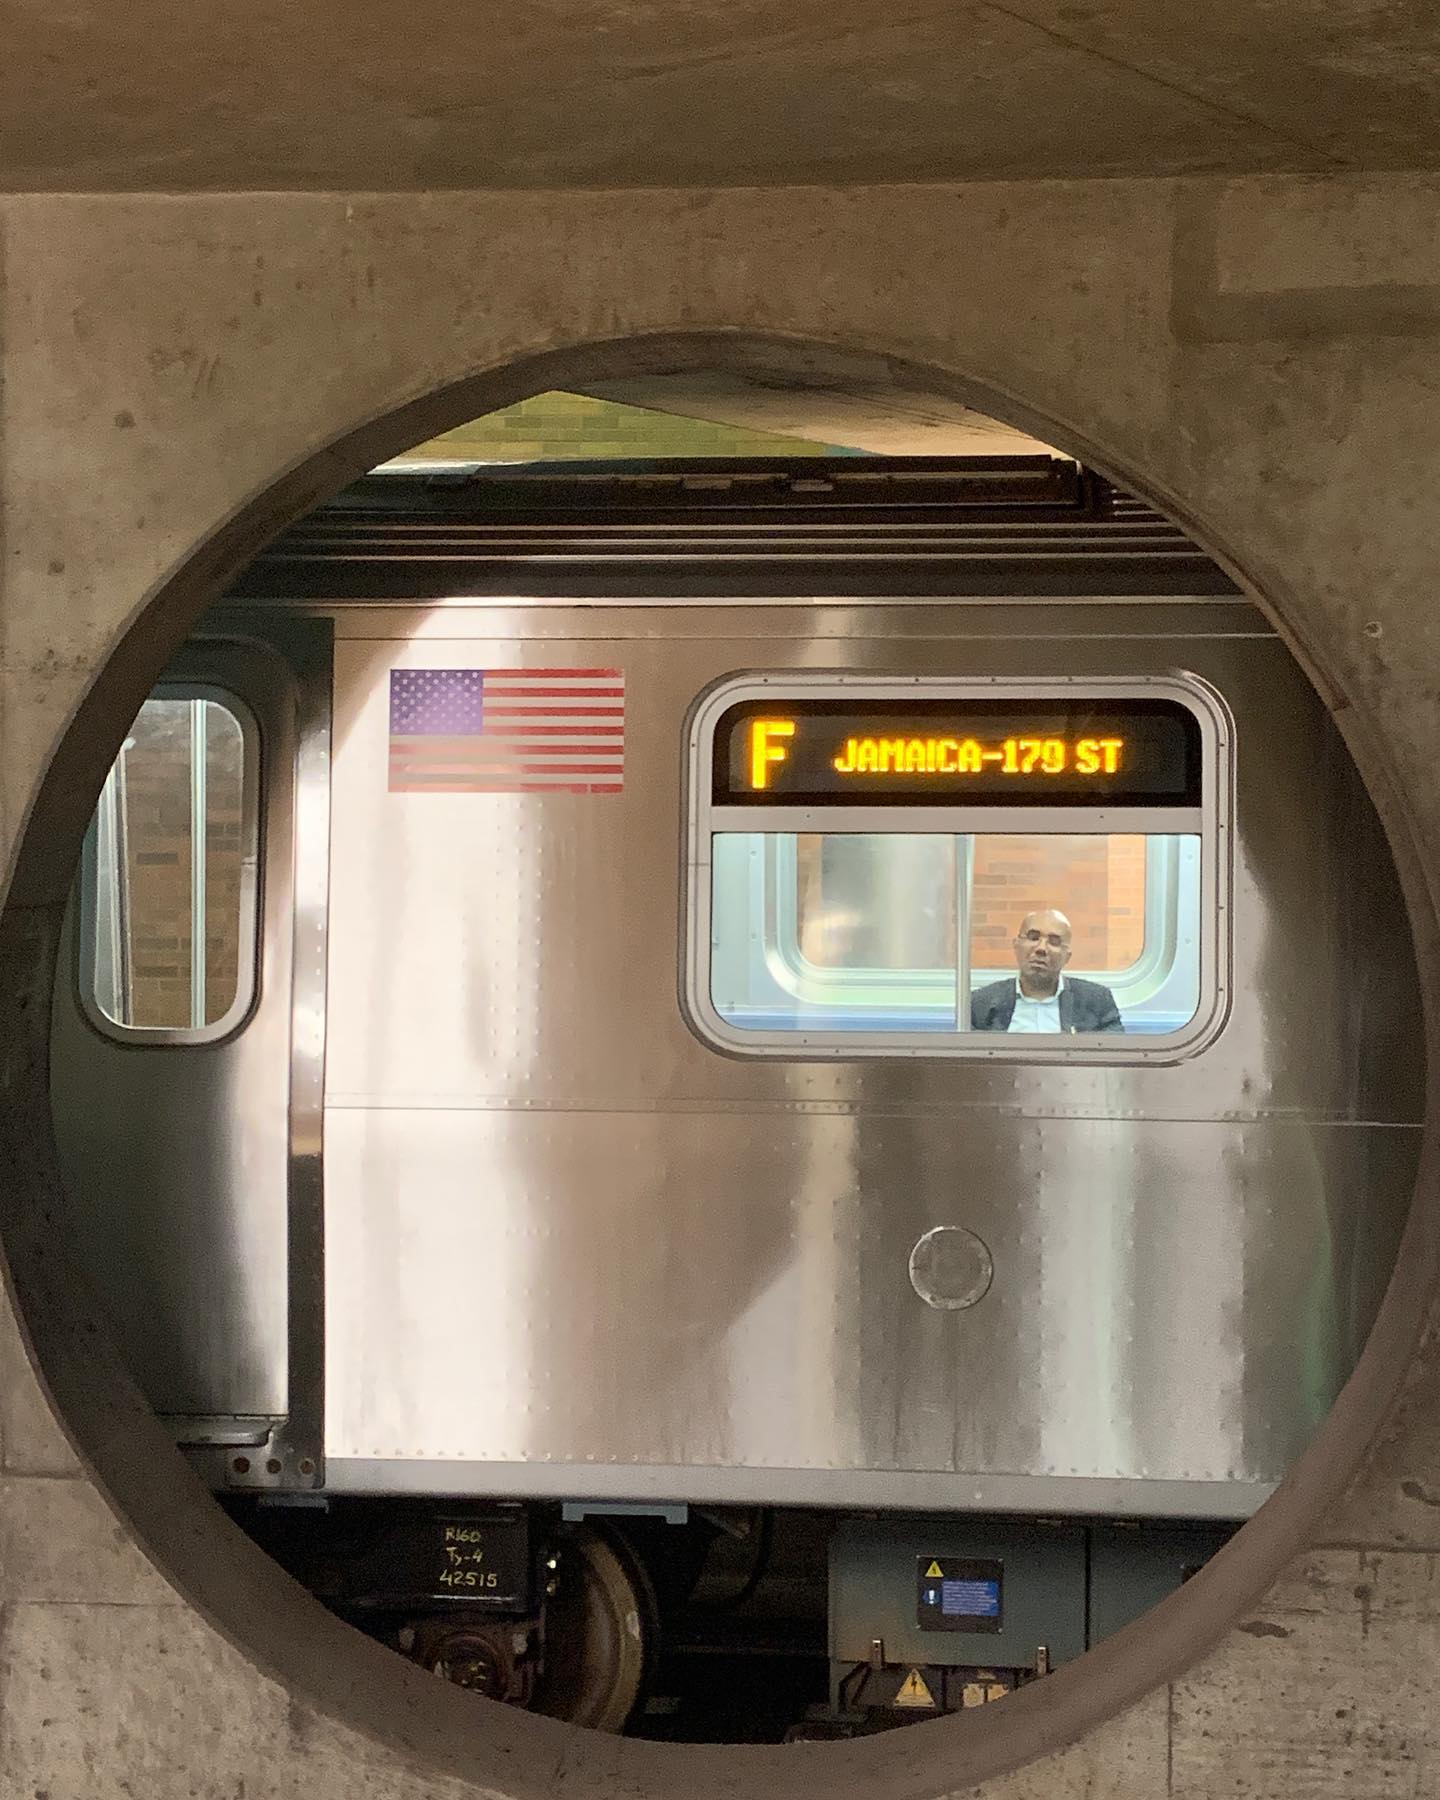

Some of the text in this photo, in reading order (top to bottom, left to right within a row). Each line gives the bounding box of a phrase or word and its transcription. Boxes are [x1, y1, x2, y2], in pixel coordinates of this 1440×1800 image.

[752, 721, 1123, 789] F JAMAICA-179 ST
[439, 1569, 497, 1587] 42515
